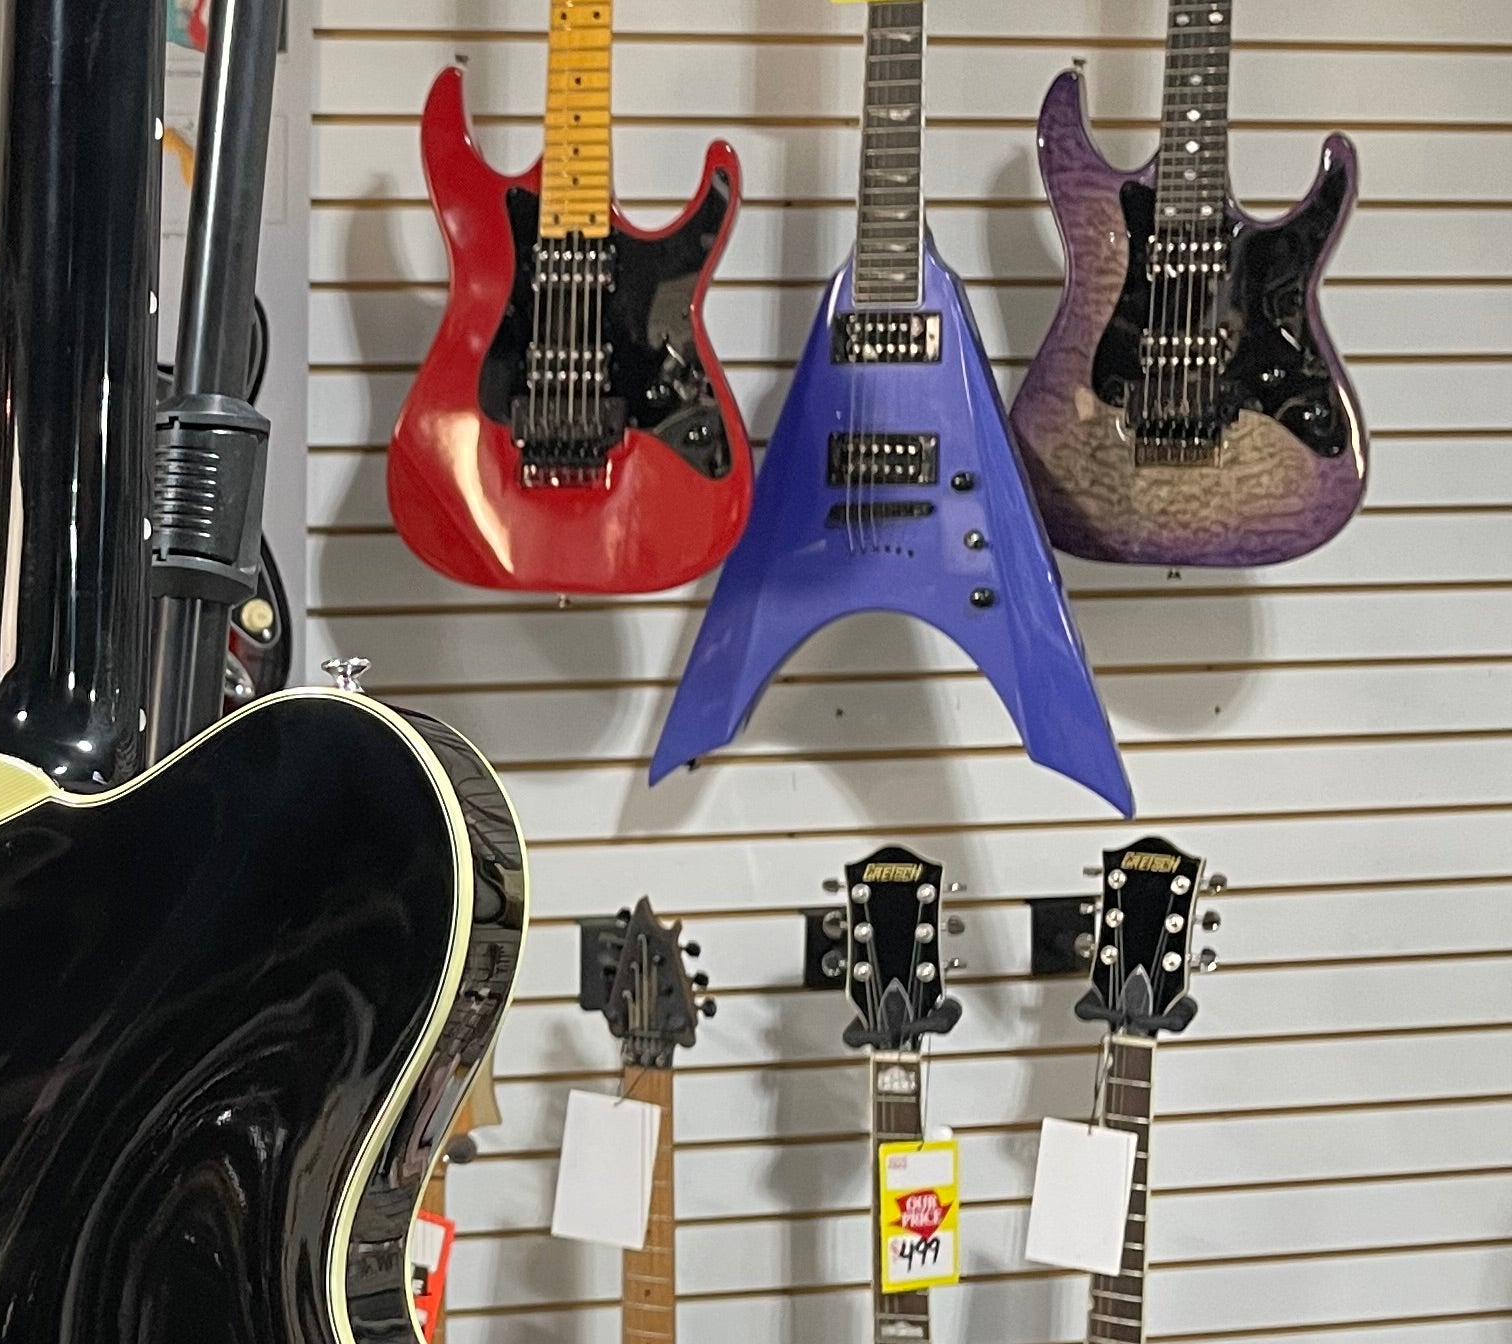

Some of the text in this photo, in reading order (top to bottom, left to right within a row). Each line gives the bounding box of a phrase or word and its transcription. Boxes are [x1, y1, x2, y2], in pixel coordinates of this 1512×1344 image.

[862, 862, 923, 883] GRETSCH
[1121, 851, 1181, 874] GRETSCH
[906, 1194, 938, 1212] OUR
